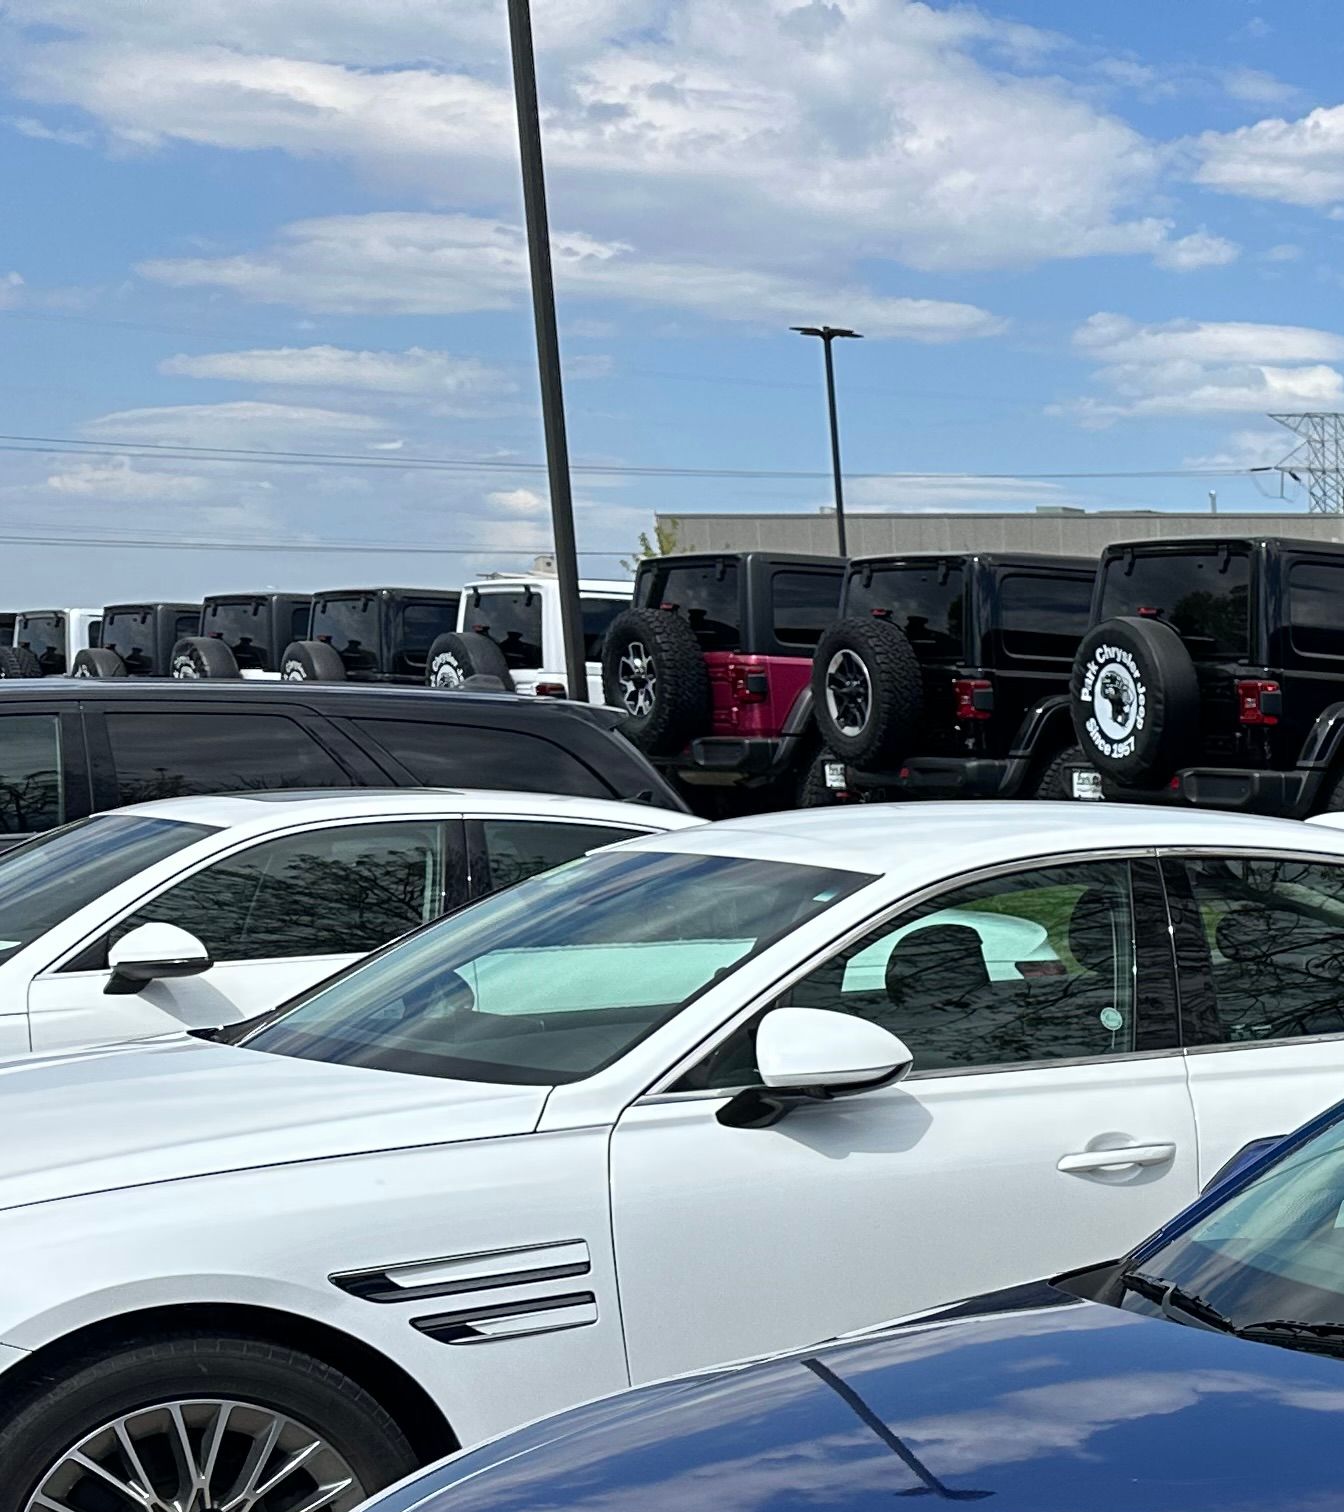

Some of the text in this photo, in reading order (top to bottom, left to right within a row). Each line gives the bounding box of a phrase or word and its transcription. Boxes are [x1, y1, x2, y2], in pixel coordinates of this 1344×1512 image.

[1081, 644, 1146, 730] Park Chrysler Jeep
[1086, 717, 1135, 758] Since 1957
